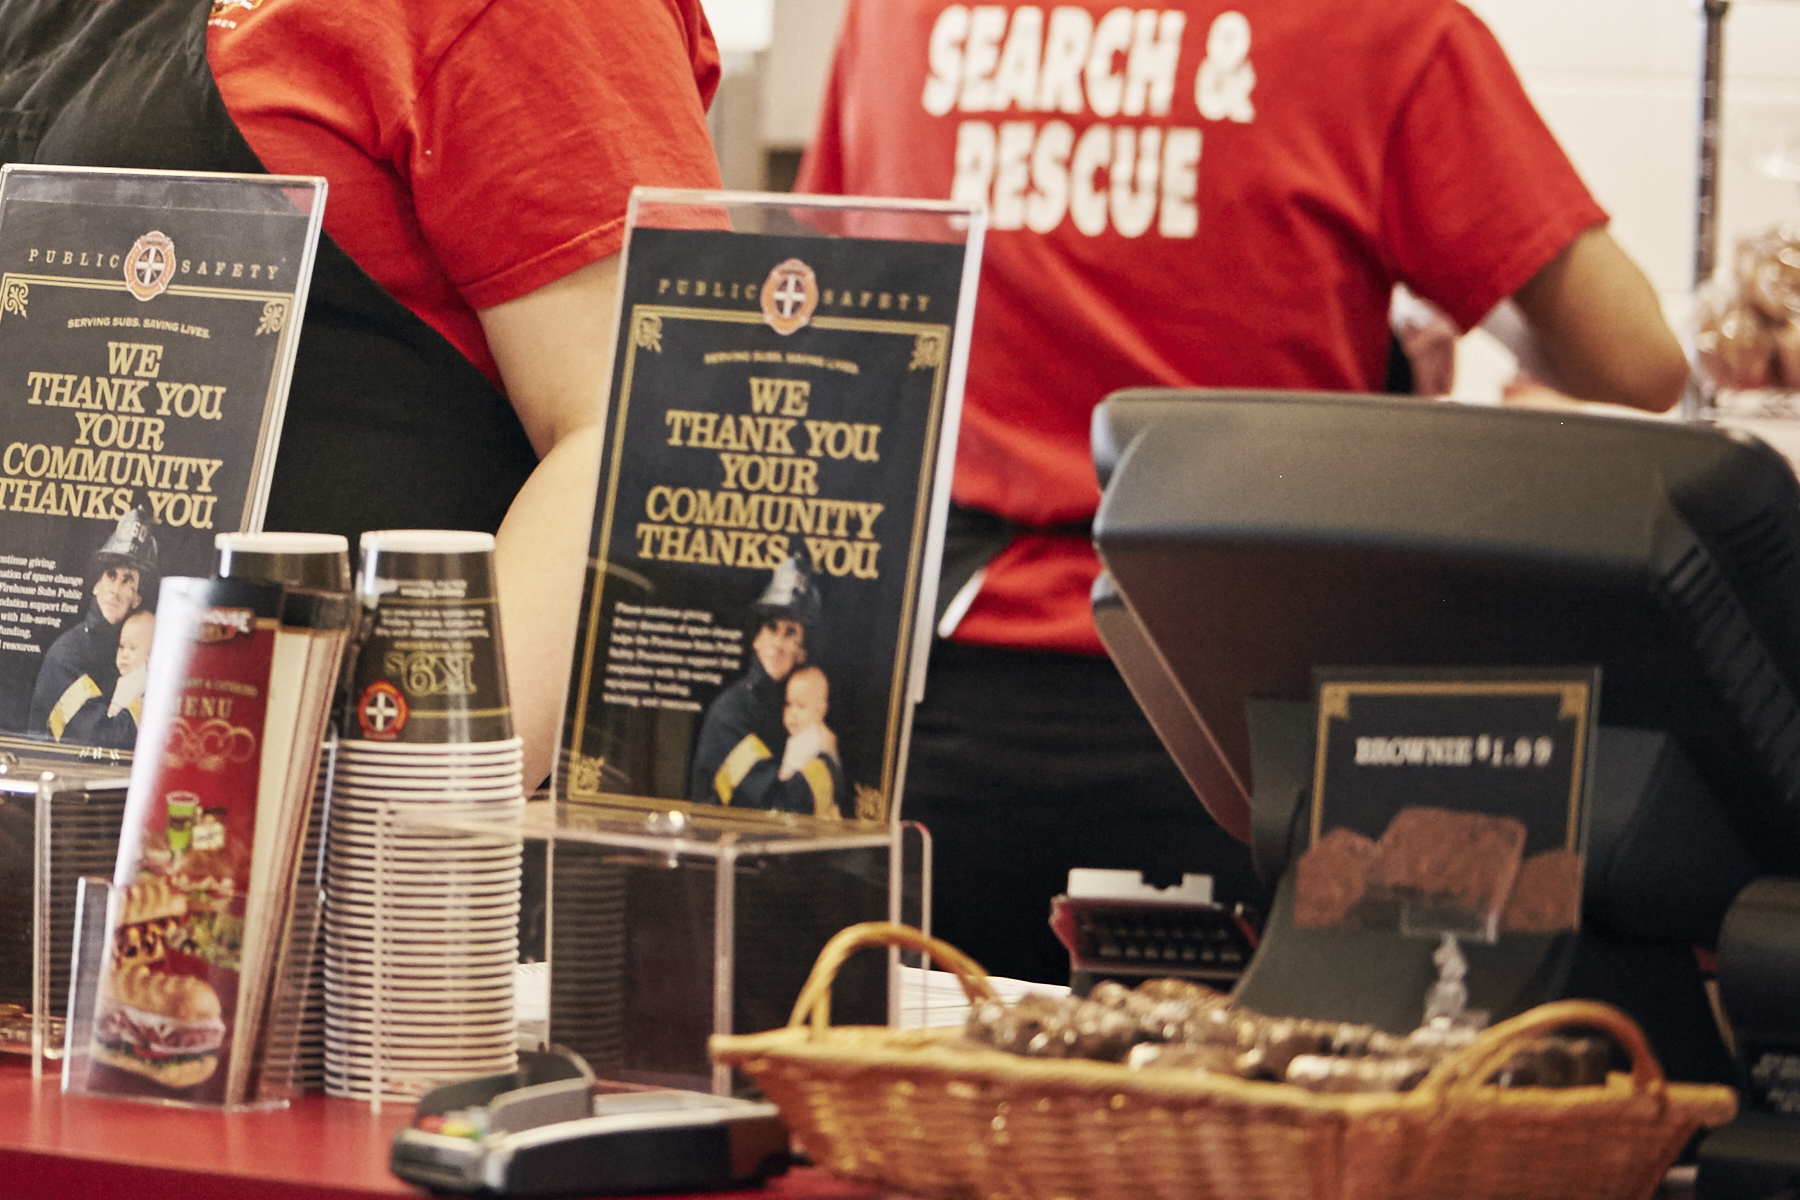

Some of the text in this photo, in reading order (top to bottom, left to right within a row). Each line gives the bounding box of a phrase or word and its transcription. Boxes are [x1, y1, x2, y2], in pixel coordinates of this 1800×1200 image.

[922, 4, 1257, 124] SEARCH &
[948, 120, 1203, 239] RESCUE
[29, 249, 280, 280] PUBLIC SAFETY
[658, 278, 931, 312] PUBLIC SAFETY
[67, 317, 110, 328] SERVING
[143, 318, 179, 332] SAVING
[107, 342, 164, 378] WE
[27, 371, 153, 413] THANK
[749, 376, 811, 417] WE
[75, 412, 165, 452] YOUR
[665, 409, 797, 455] THANK
[3, 443, 223, 492] COMMUNITY
[719, 452, 819, 496] YOUR
[645, 485, 884, 540] COMMUNITY
[635, 522, 790, 571] THANKS
[22, 571, 32, 580] of
[31, 573, 54, 583] spare
[54, 574, 84, 587] change
[37, 586, 56, 597] Subs
[57, 588, 83, 600] Public
[1, 612, 18, 622] with
[29, 602, 60, 613] support
[60, 602, 79, 614] first
[1354, 736, 1474, 767] BROWNIE
